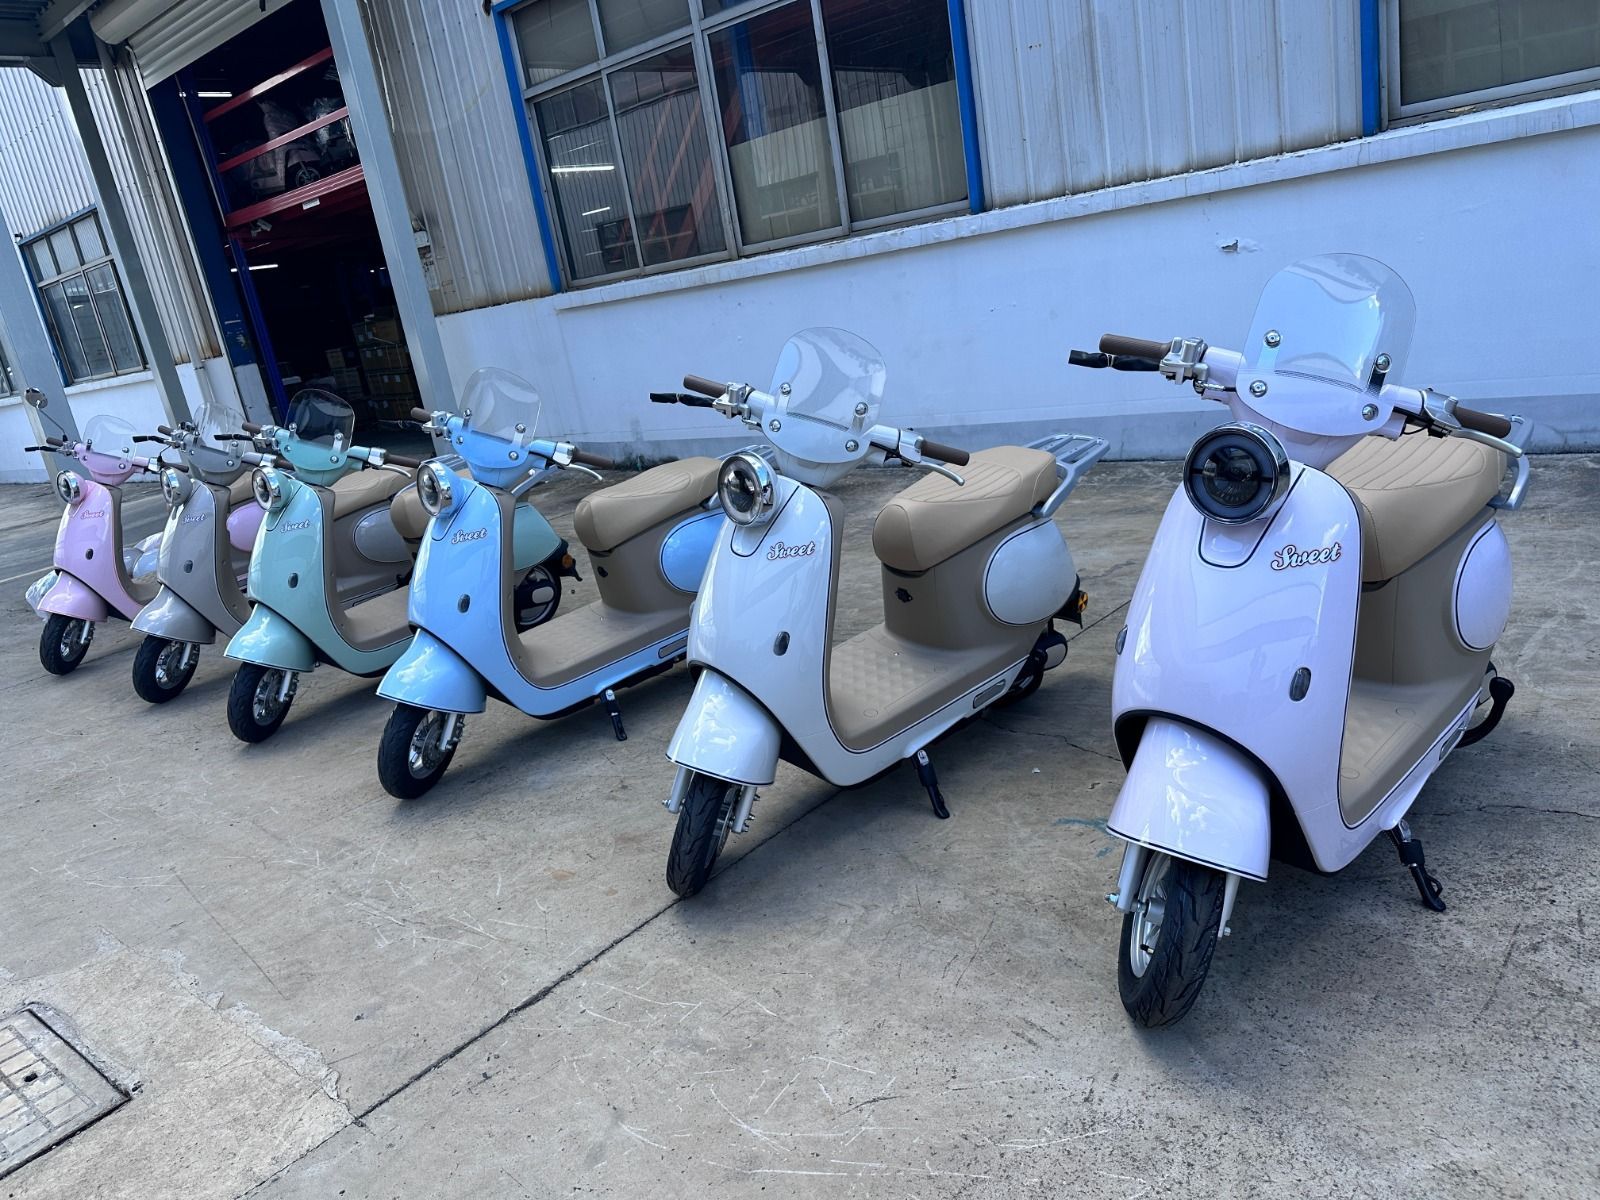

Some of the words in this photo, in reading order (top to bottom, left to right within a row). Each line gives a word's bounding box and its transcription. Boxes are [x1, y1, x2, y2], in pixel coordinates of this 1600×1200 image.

[451, 527, 488, 544] Sweet
[767, 541, 816, 561] Sweet
[1270, 542, 1342, 571] Sweet
